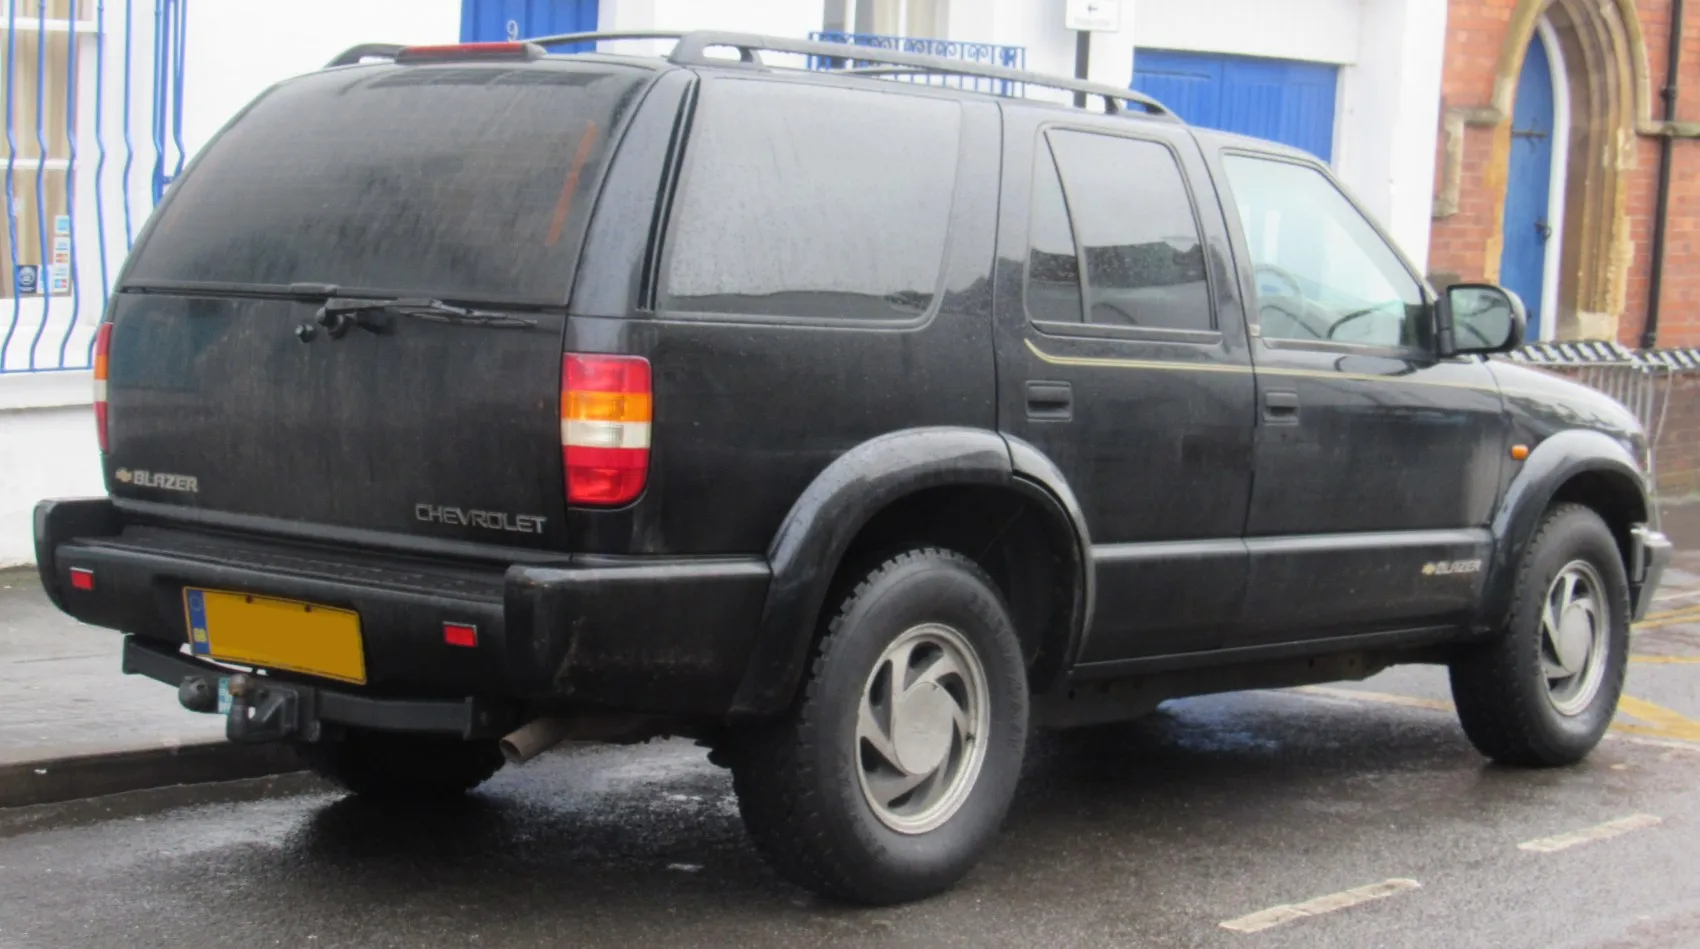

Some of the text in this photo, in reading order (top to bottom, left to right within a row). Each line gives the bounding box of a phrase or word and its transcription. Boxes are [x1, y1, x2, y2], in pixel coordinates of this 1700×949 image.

[506, 19, 519, 42] 9
[133, 470, 199, 492] BLAZER
[415, 503, 546, 534] CHEVROLET
[1436, 559, 1482, 574] BLAZER
